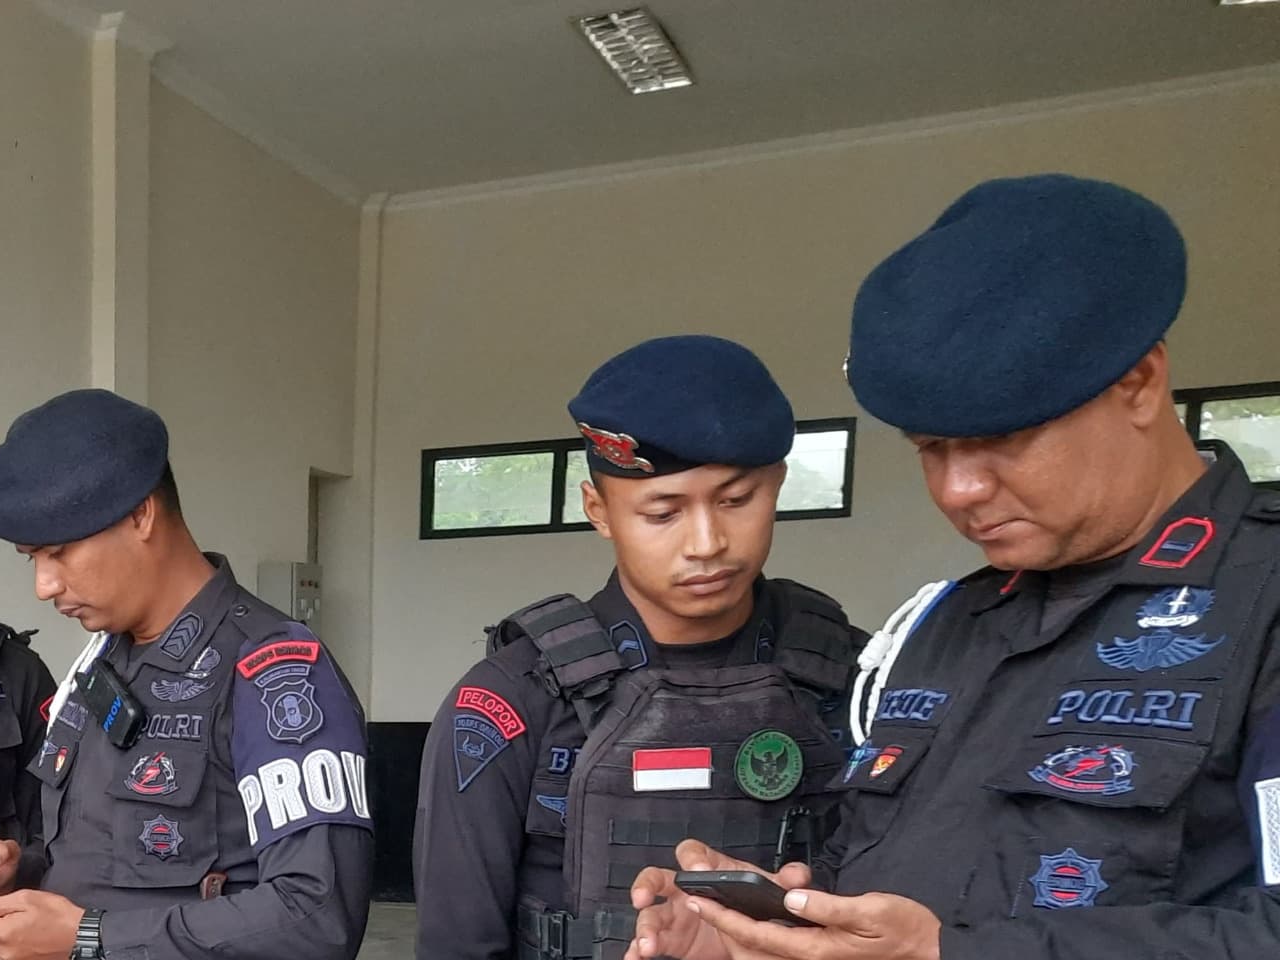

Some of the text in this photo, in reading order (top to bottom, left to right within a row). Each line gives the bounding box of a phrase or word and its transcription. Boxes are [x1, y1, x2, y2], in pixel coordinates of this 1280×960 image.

[103, 696, 124, 733] PROV
[139, 713, 203, 740] OLRI
[463, 691, 518, 733] PELOPOR
[1046, 688, 1203, 731] POLRI
[237, 748, 371, 847] PROV
